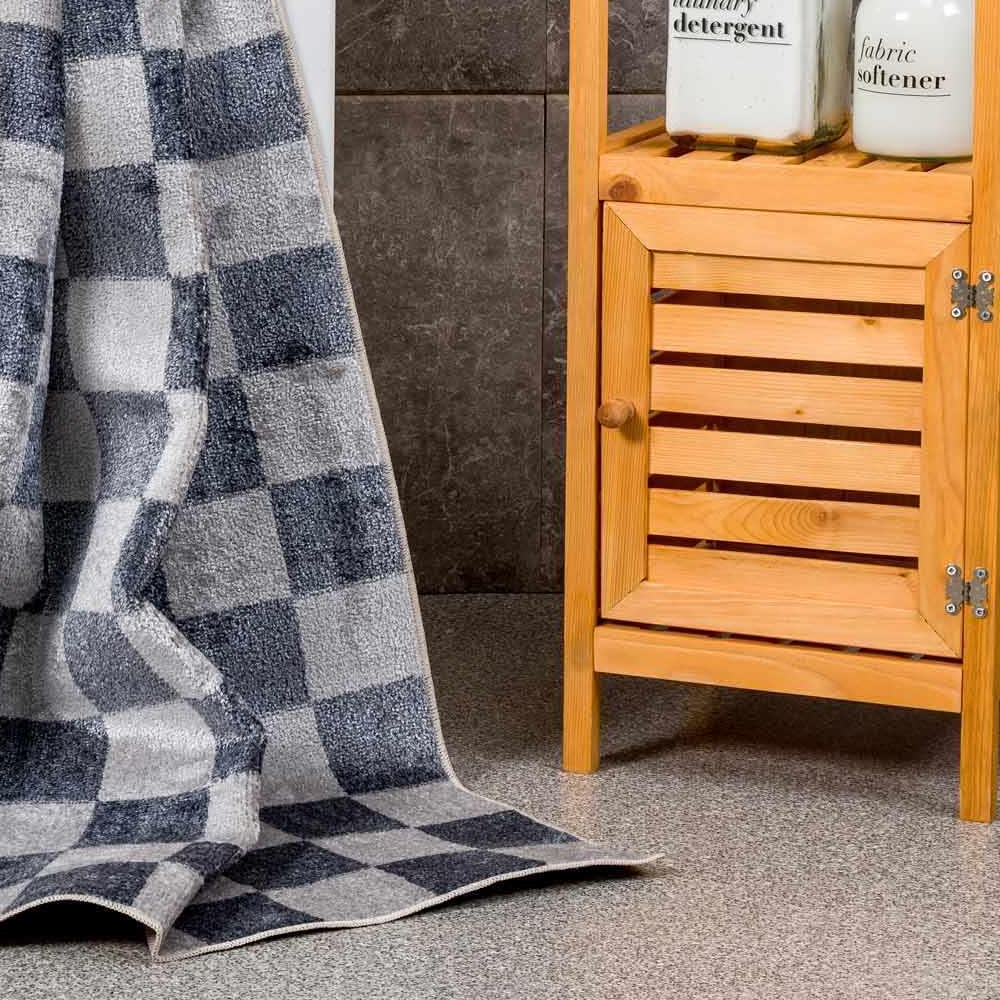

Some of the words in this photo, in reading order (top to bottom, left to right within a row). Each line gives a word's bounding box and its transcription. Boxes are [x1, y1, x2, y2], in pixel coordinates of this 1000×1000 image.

[672, 12, 785, 43] detergent
[858, 35, 918, 64] fabric
[856, 64, 946, 90] softener
